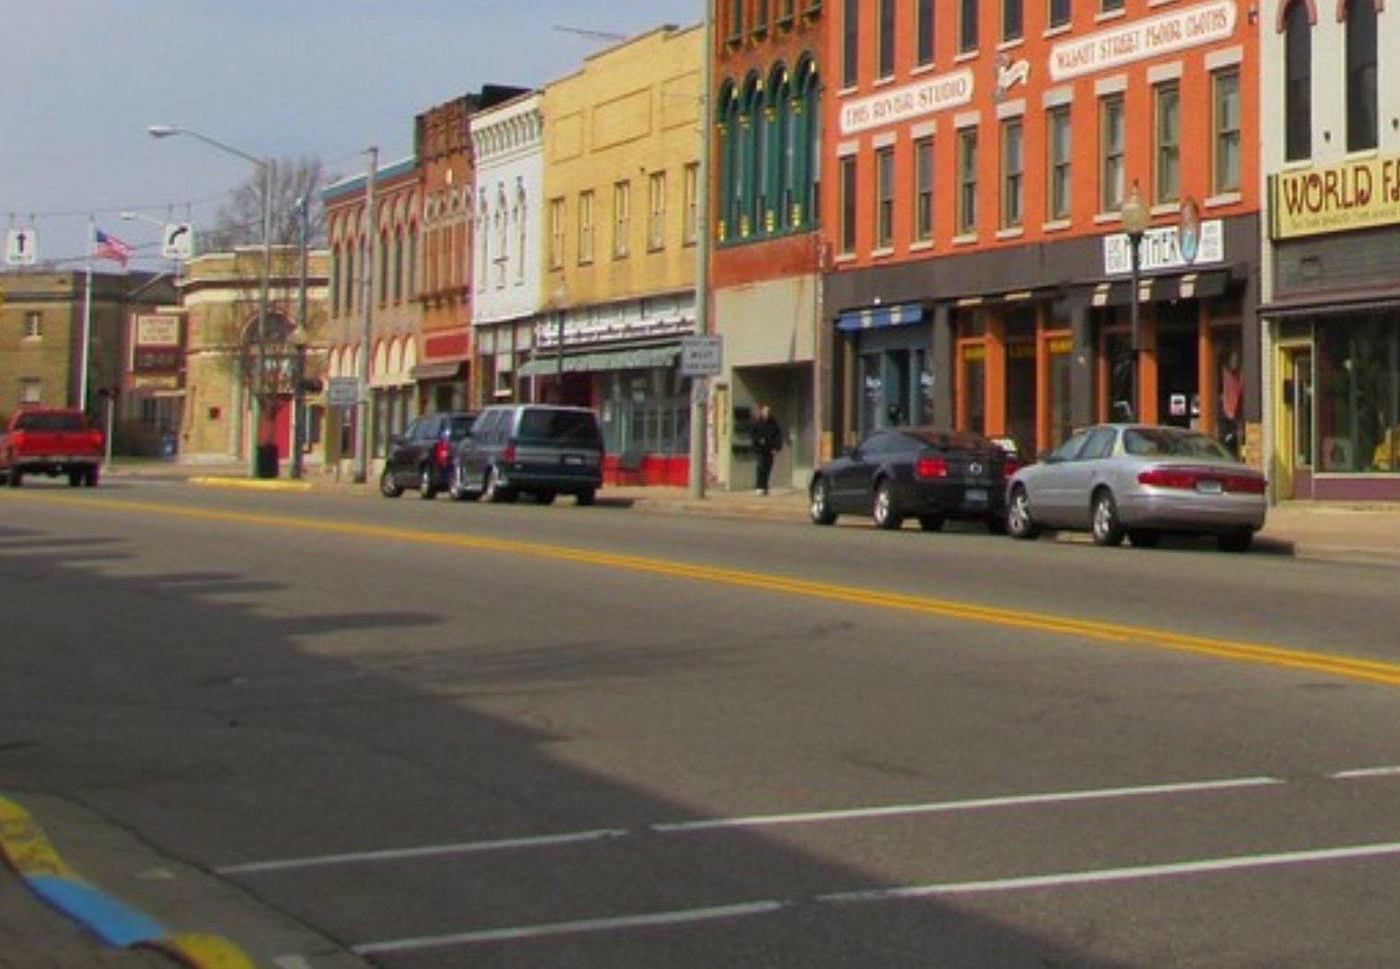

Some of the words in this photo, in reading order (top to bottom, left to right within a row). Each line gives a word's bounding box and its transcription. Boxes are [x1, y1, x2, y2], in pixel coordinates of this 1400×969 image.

[1099, 30, 1139, 59] STREET
[918, 76, 967, 108] STUDIO
[1283, 164, 1373, 216] WORLD
